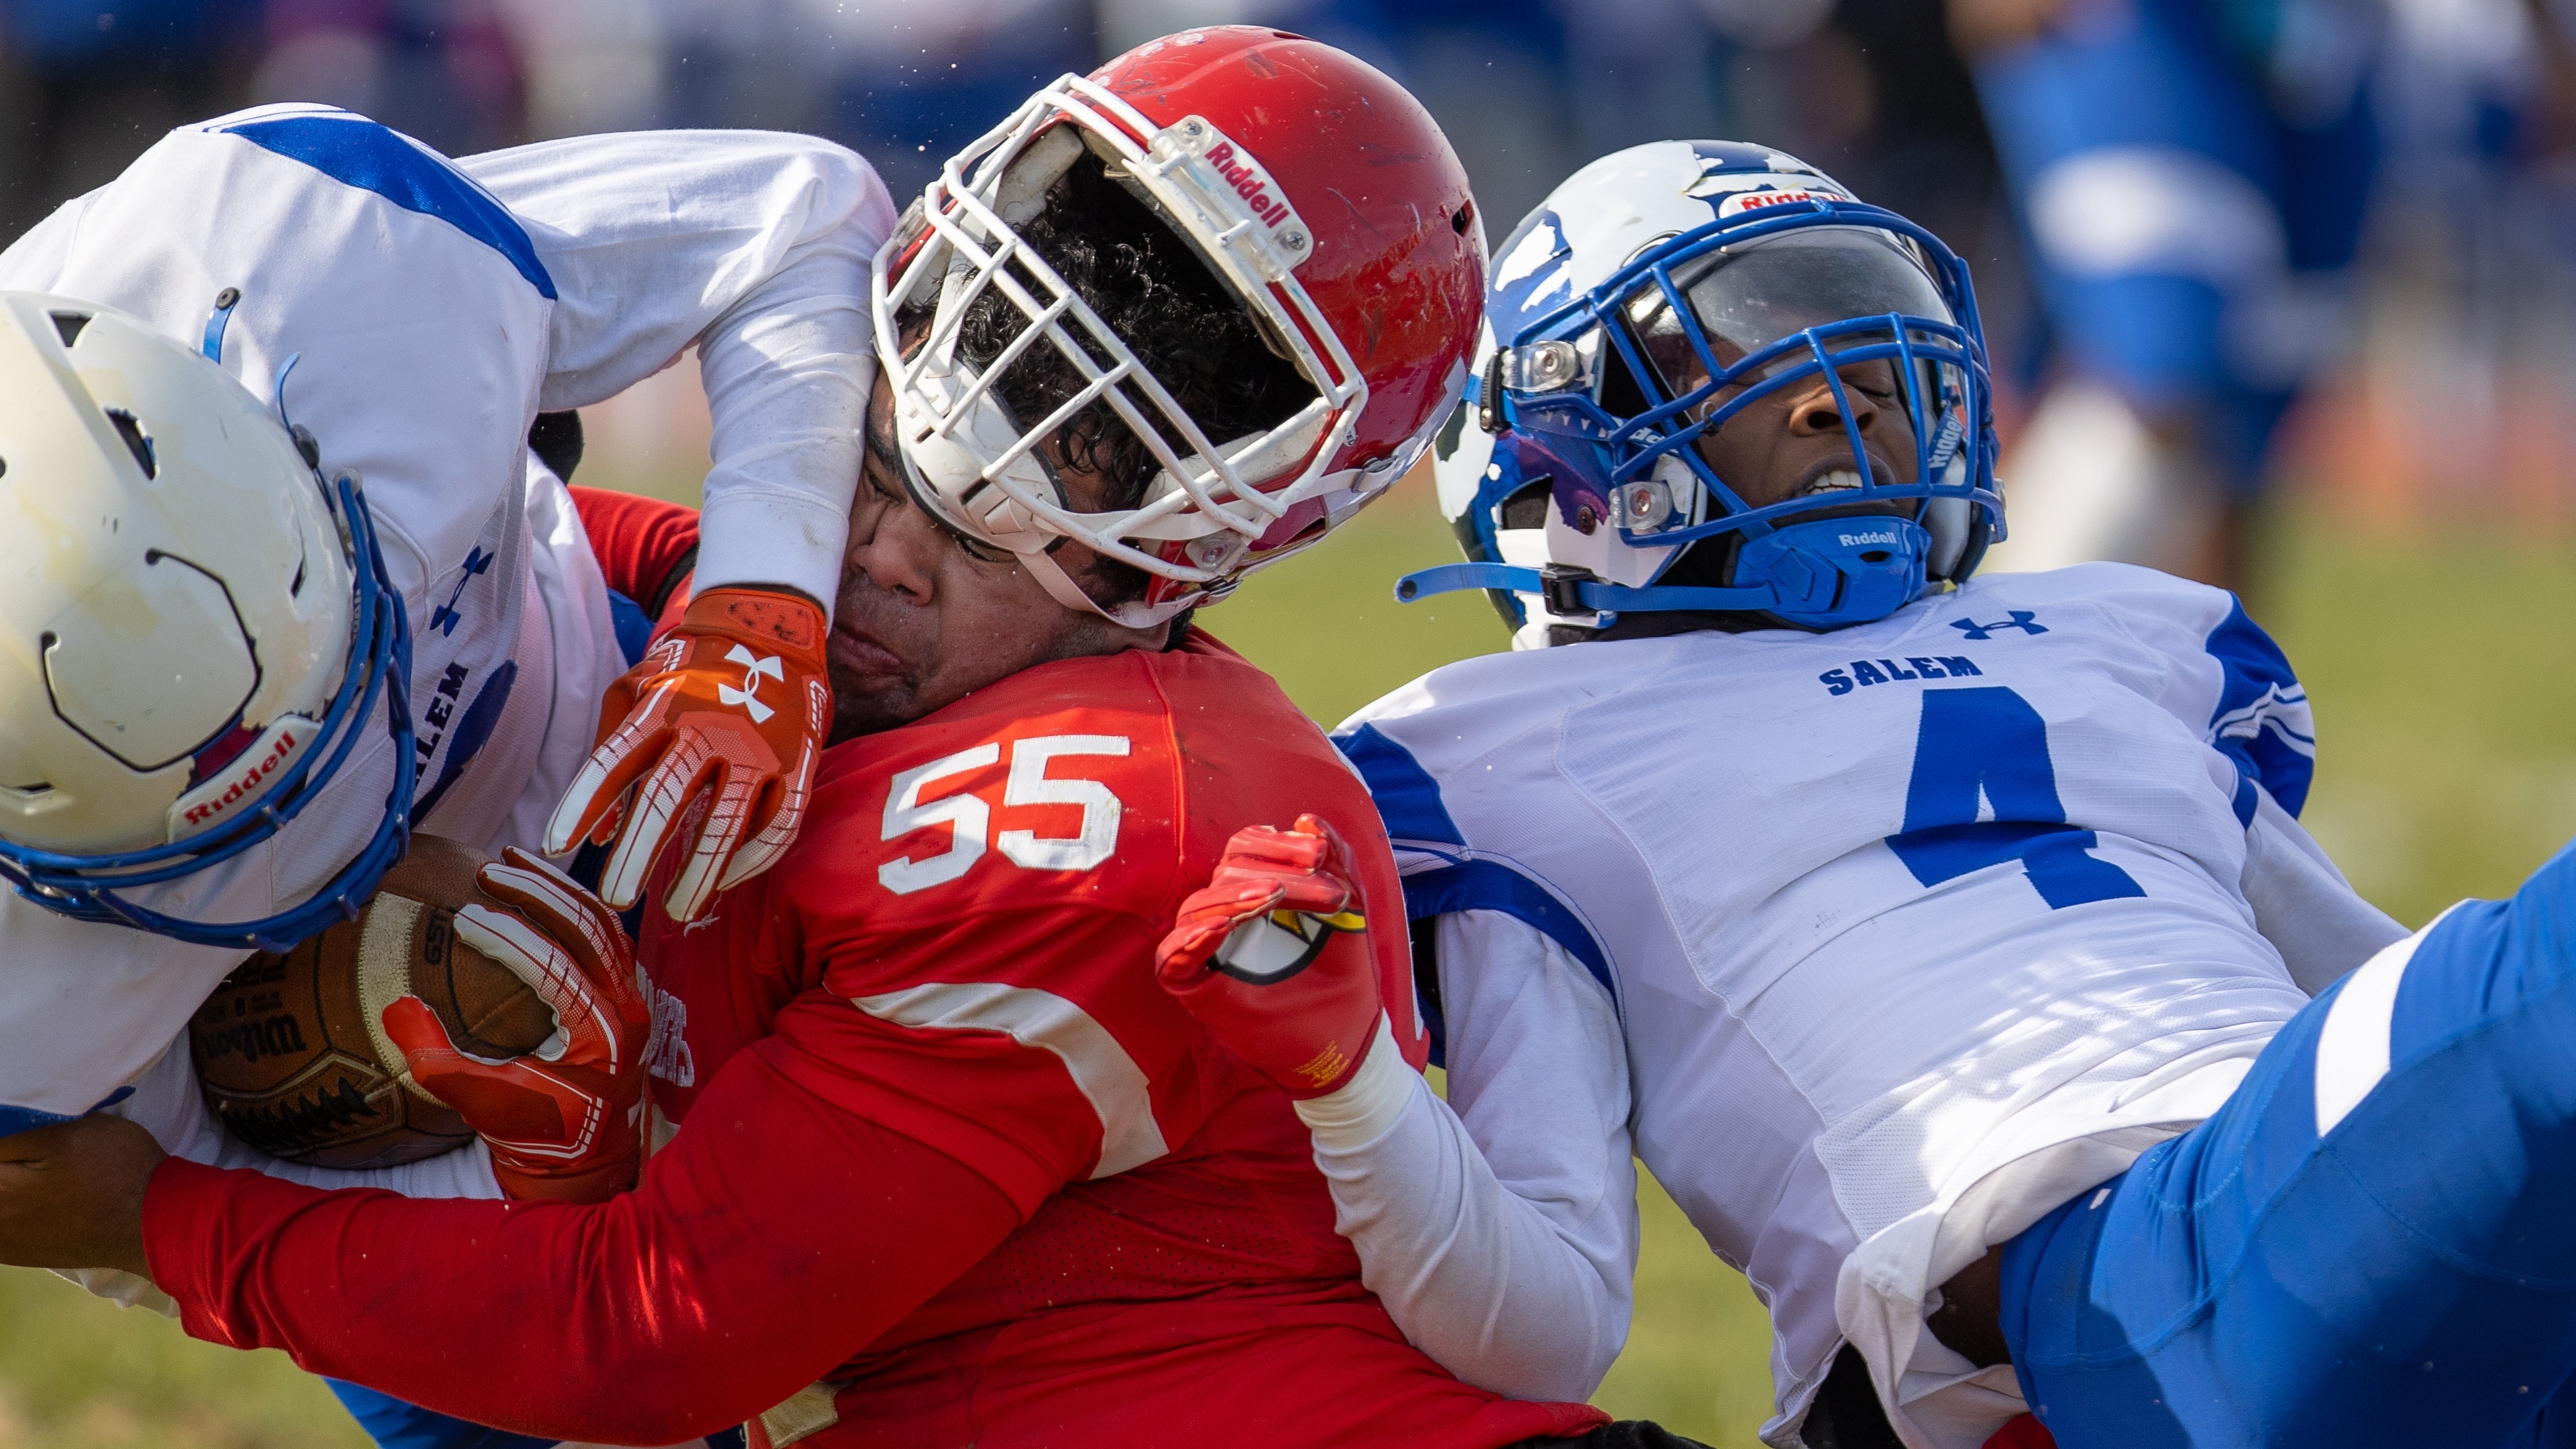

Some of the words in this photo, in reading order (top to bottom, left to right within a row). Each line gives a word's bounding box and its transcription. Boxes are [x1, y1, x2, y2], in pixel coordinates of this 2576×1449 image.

[1205, 141, 1290, 228] Riddell
[1739, 192, 1845, 210] Ridd
[1928, 419, 1964, 468] Ridde
[1838, 531, 1897, 547] Riddell
[1819, 656, 1983, 696] SALEM
[415, 660, 469, 789] LEM
[184, 730, 295, 825] Riddell
[1884, 686, 2148, 910] 4
[878, 734, 1130, 896] 55
[204, 1014, 307, 1062] Wilson
